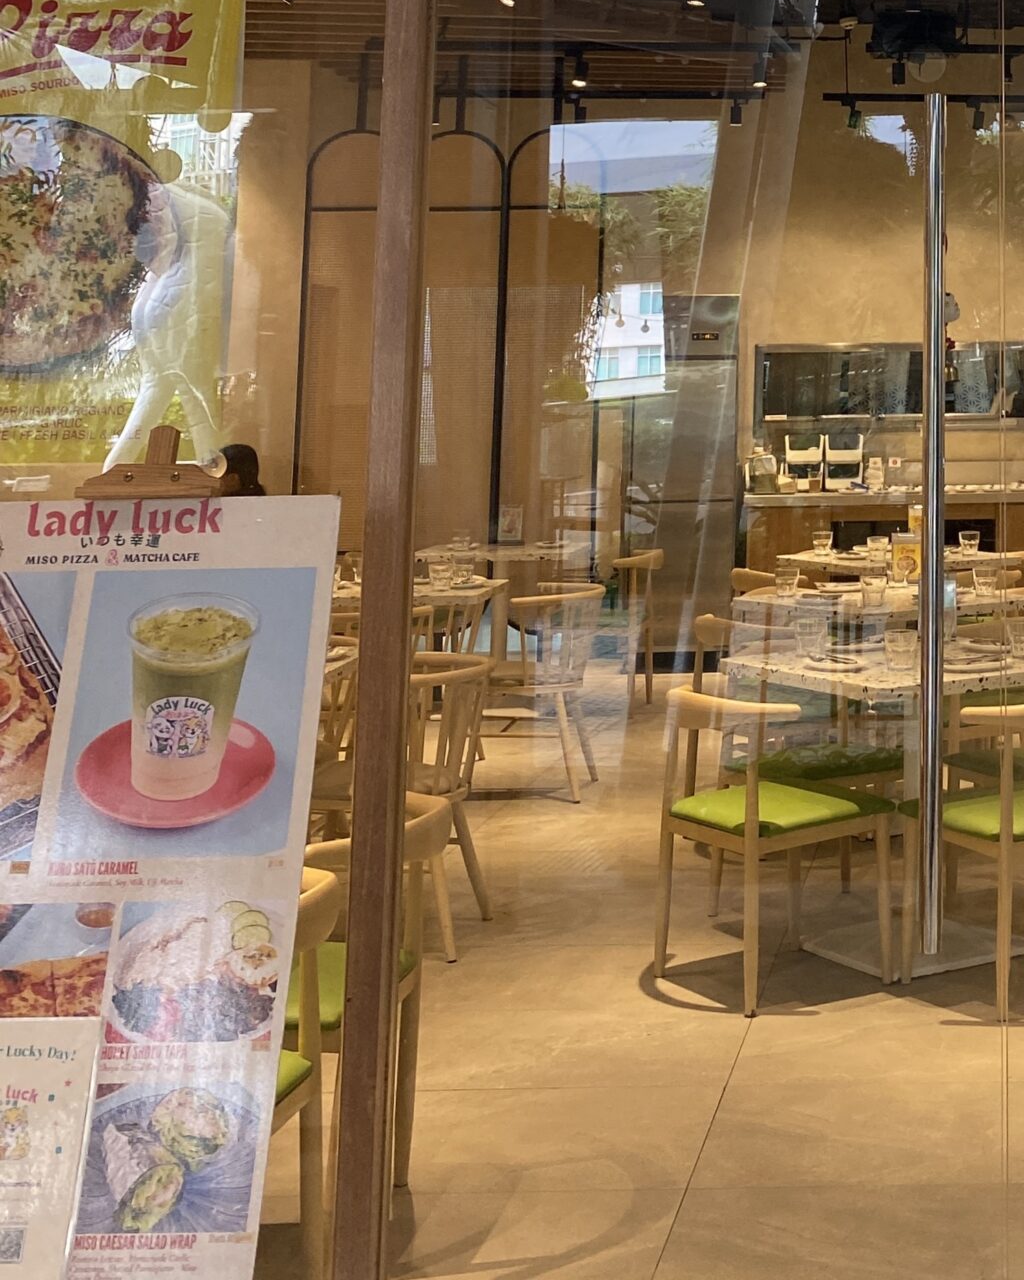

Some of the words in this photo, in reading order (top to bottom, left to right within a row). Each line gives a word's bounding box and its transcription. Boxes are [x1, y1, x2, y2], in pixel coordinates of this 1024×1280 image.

[25, 555, 58, 565] MISO
[62, 554, 99, 564] PIZZA
[105, 549, 119, 566] &
[123, 553, 170, 563] MATCHA
[172, 552, 200, 562] CAFE
[98, 861, 138, 875] CARAMEL
[7, 1045, 42, 1061] Lucky
[48, 1046, 77, 1063] Day!
[74, 1234, 97, 1250] MISO
[100, 1234, 136, 1250] CAESAR
[137, 1234, 168, 1250] SALAD
[170, 1233, 198, 1250] WRAP
